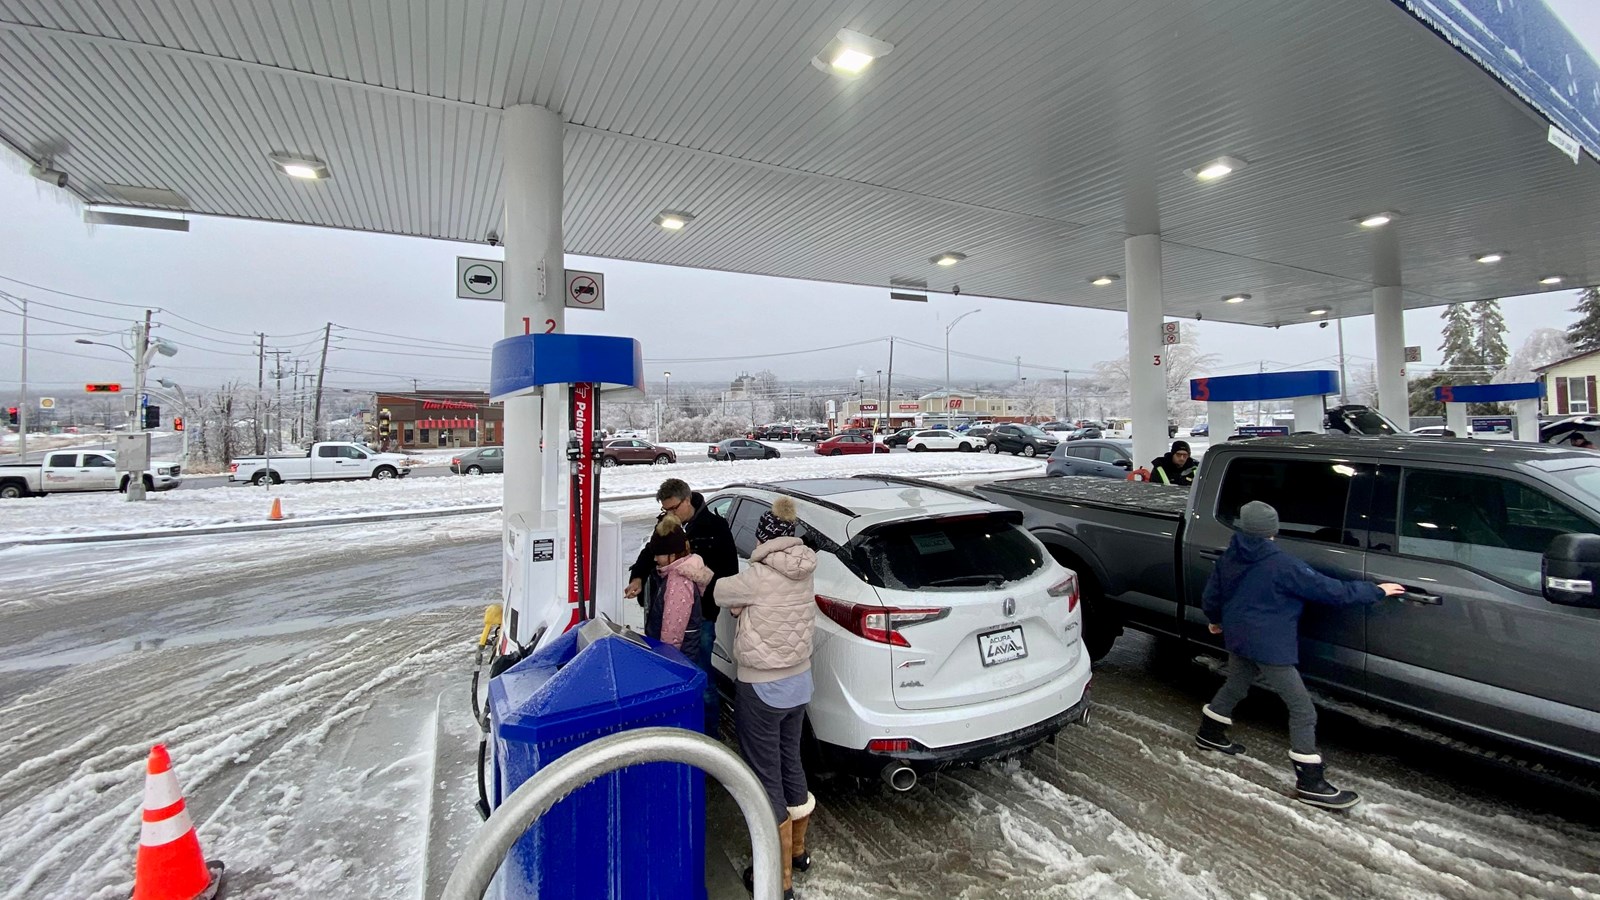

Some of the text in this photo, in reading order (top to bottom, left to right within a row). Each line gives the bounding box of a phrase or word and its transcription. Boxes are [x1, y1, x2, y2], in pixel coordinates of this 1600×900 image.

[522, 317, 556, 335] 1 2
[1153, 355, 1161, 365] 3
[1400, 369, 1405, 377] 5
[1195, 378, 1210, 401] 3
[1441, 385, 1454, 402] 5
[989, 634, 1012, 645] ACURA
[987, 640, 1023, 658] LAVAL
